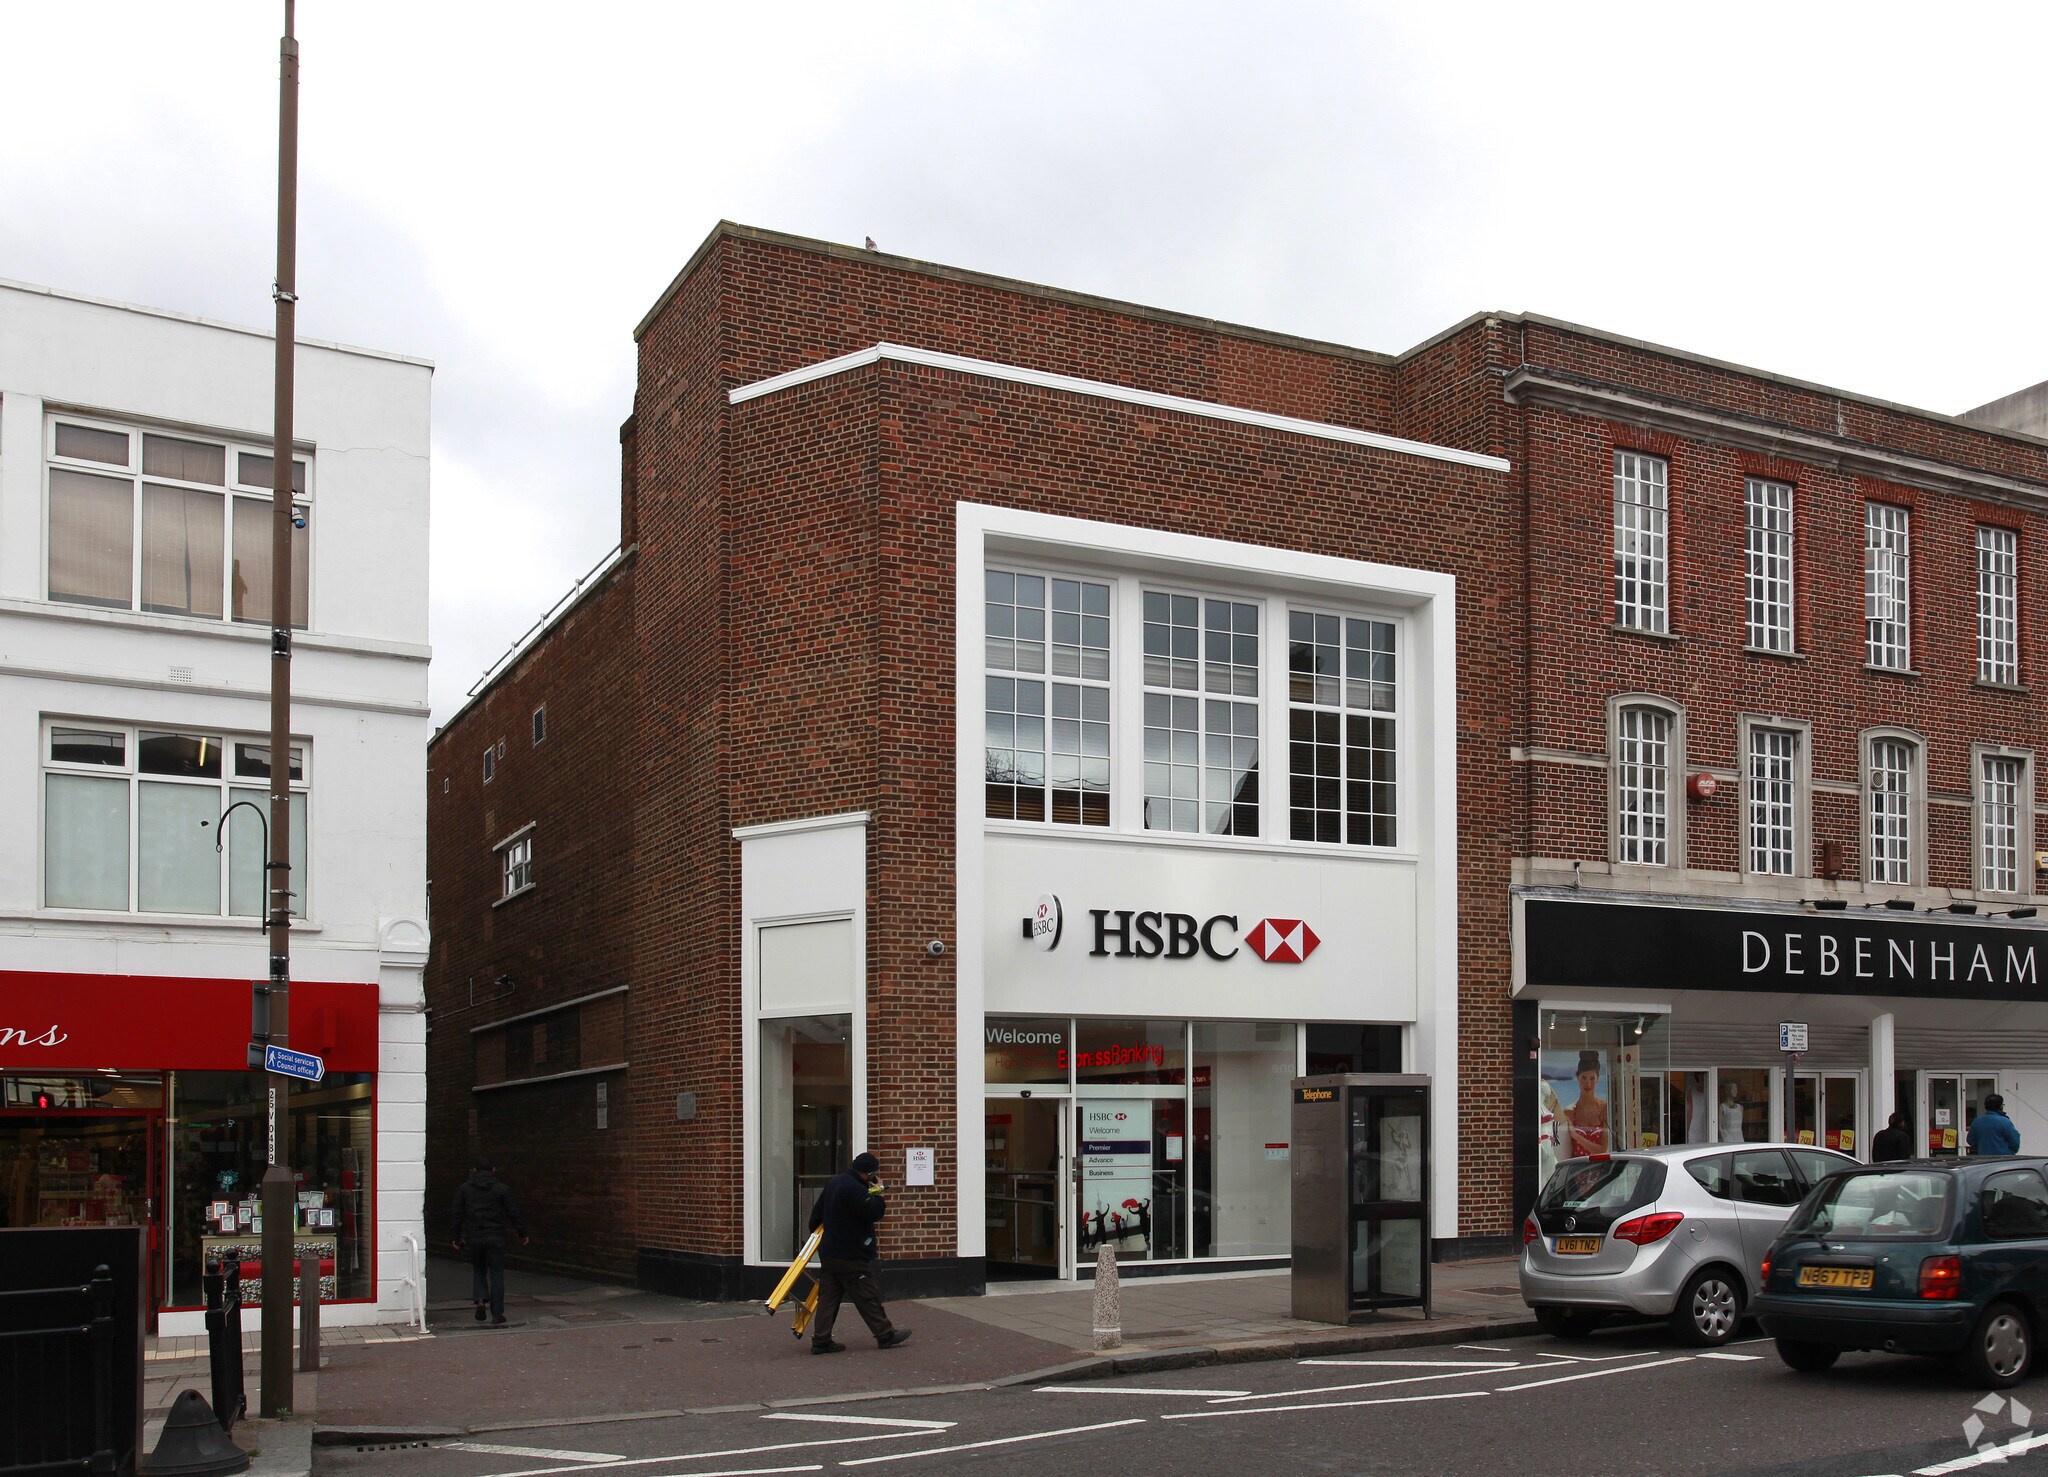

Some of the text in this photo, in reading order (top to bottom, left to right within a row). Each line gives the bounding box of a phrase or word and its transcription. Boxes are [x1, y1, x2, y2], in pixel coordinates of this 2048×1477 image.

[1033, 917, 1054, 937] HSBC
[1088, 909, 1240, 962] HSBC
[1741, 930, 2038, 985] DEBENHAM
[985, 1028, 1062, 1044] Welcome
[277, 1051, 315, 1067] Social services
[276, 1060, 315, 1076] Council offices
[1302, 1089, 1333, 1102] Telephone
[1089, 1112, 1113, 1121] HSBC
[1089, 1127, 1121, 1135] Welcome
[1088, 1169, 1114, 1177] Business
[1559, 1240, 1597, 1251] LV61 TNZ
[1802, 1269, 1840, 1284] N867
[1843, 1271, 1871, 1286] TPB
